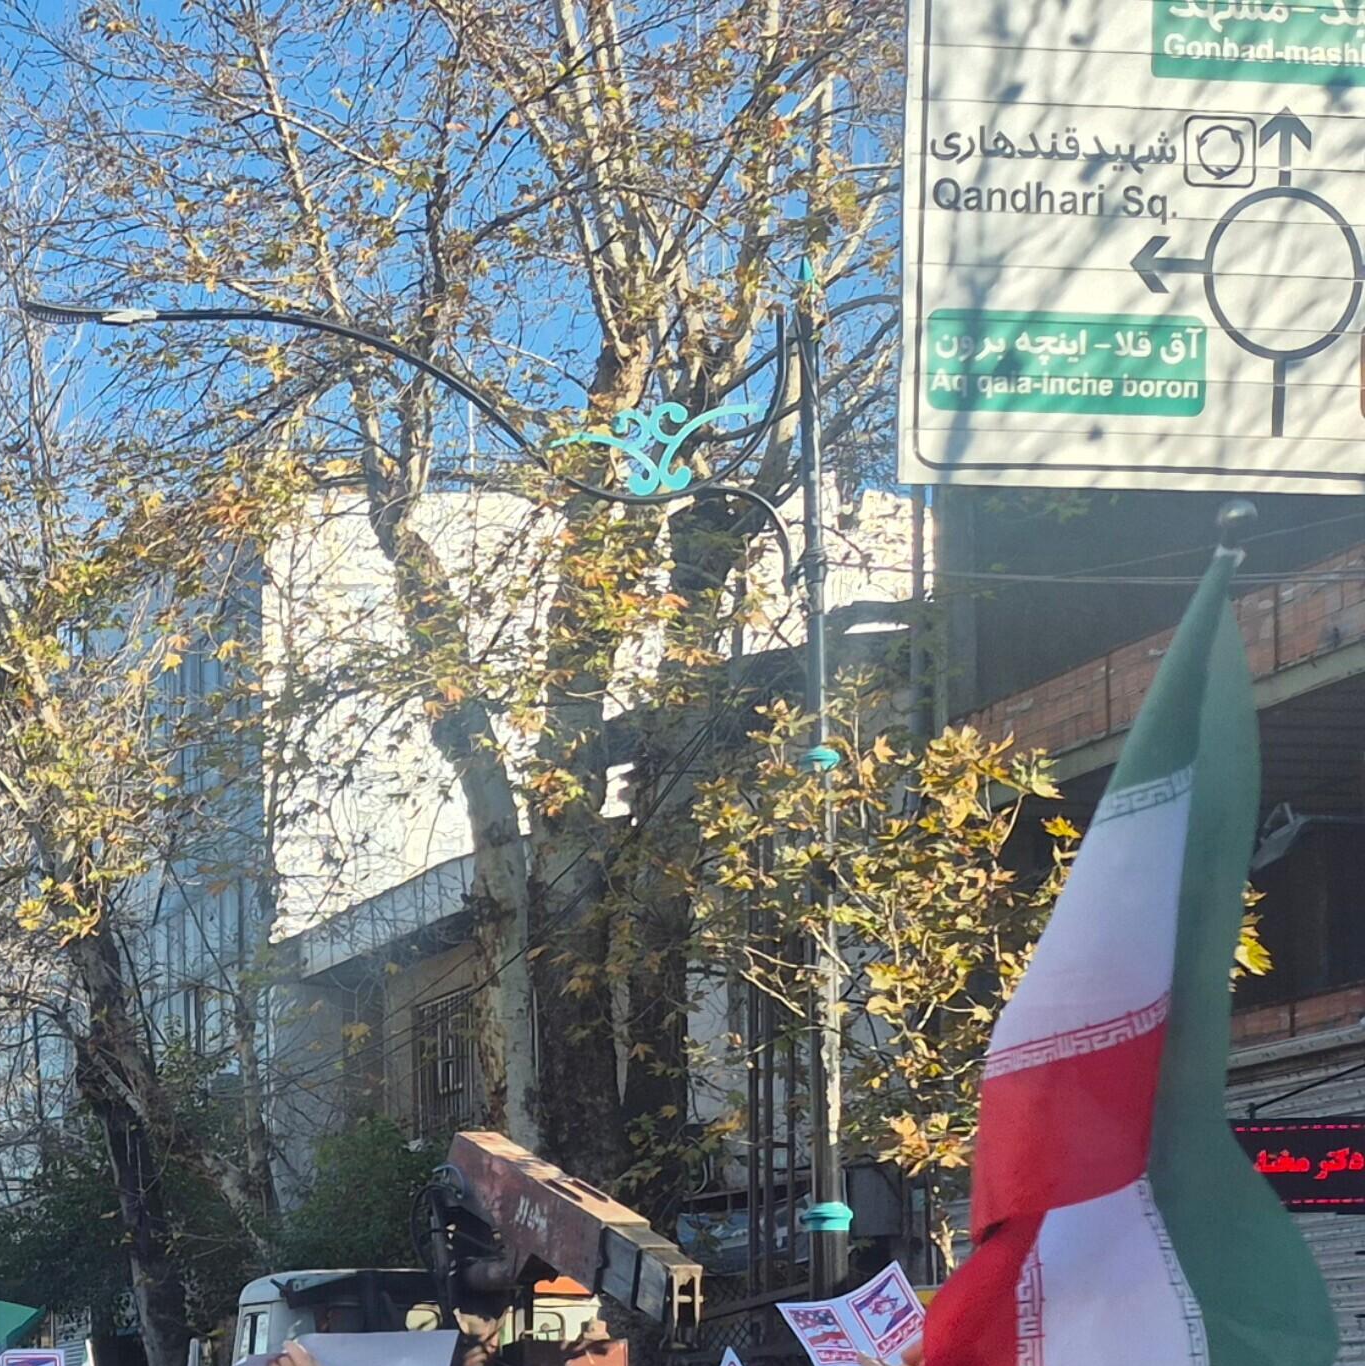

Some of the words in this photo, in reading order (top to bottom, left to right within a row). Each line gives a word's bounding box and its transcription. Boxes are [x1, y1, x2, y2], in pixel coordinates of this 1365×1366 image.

[1163, 32, 1365, 67] Gonbad-mash
[932, 177, 1105, 215] Qandhari
[1122, 185, 1178, 225] Sq.
[934, 333, 1007, 361] برون
[1015, 329, 1087, 365] اینچه
[1159, 327, 1203, 365] آق
[930, 367, 969, 397] Aq
[1121, 374, 1199, 399] boron
